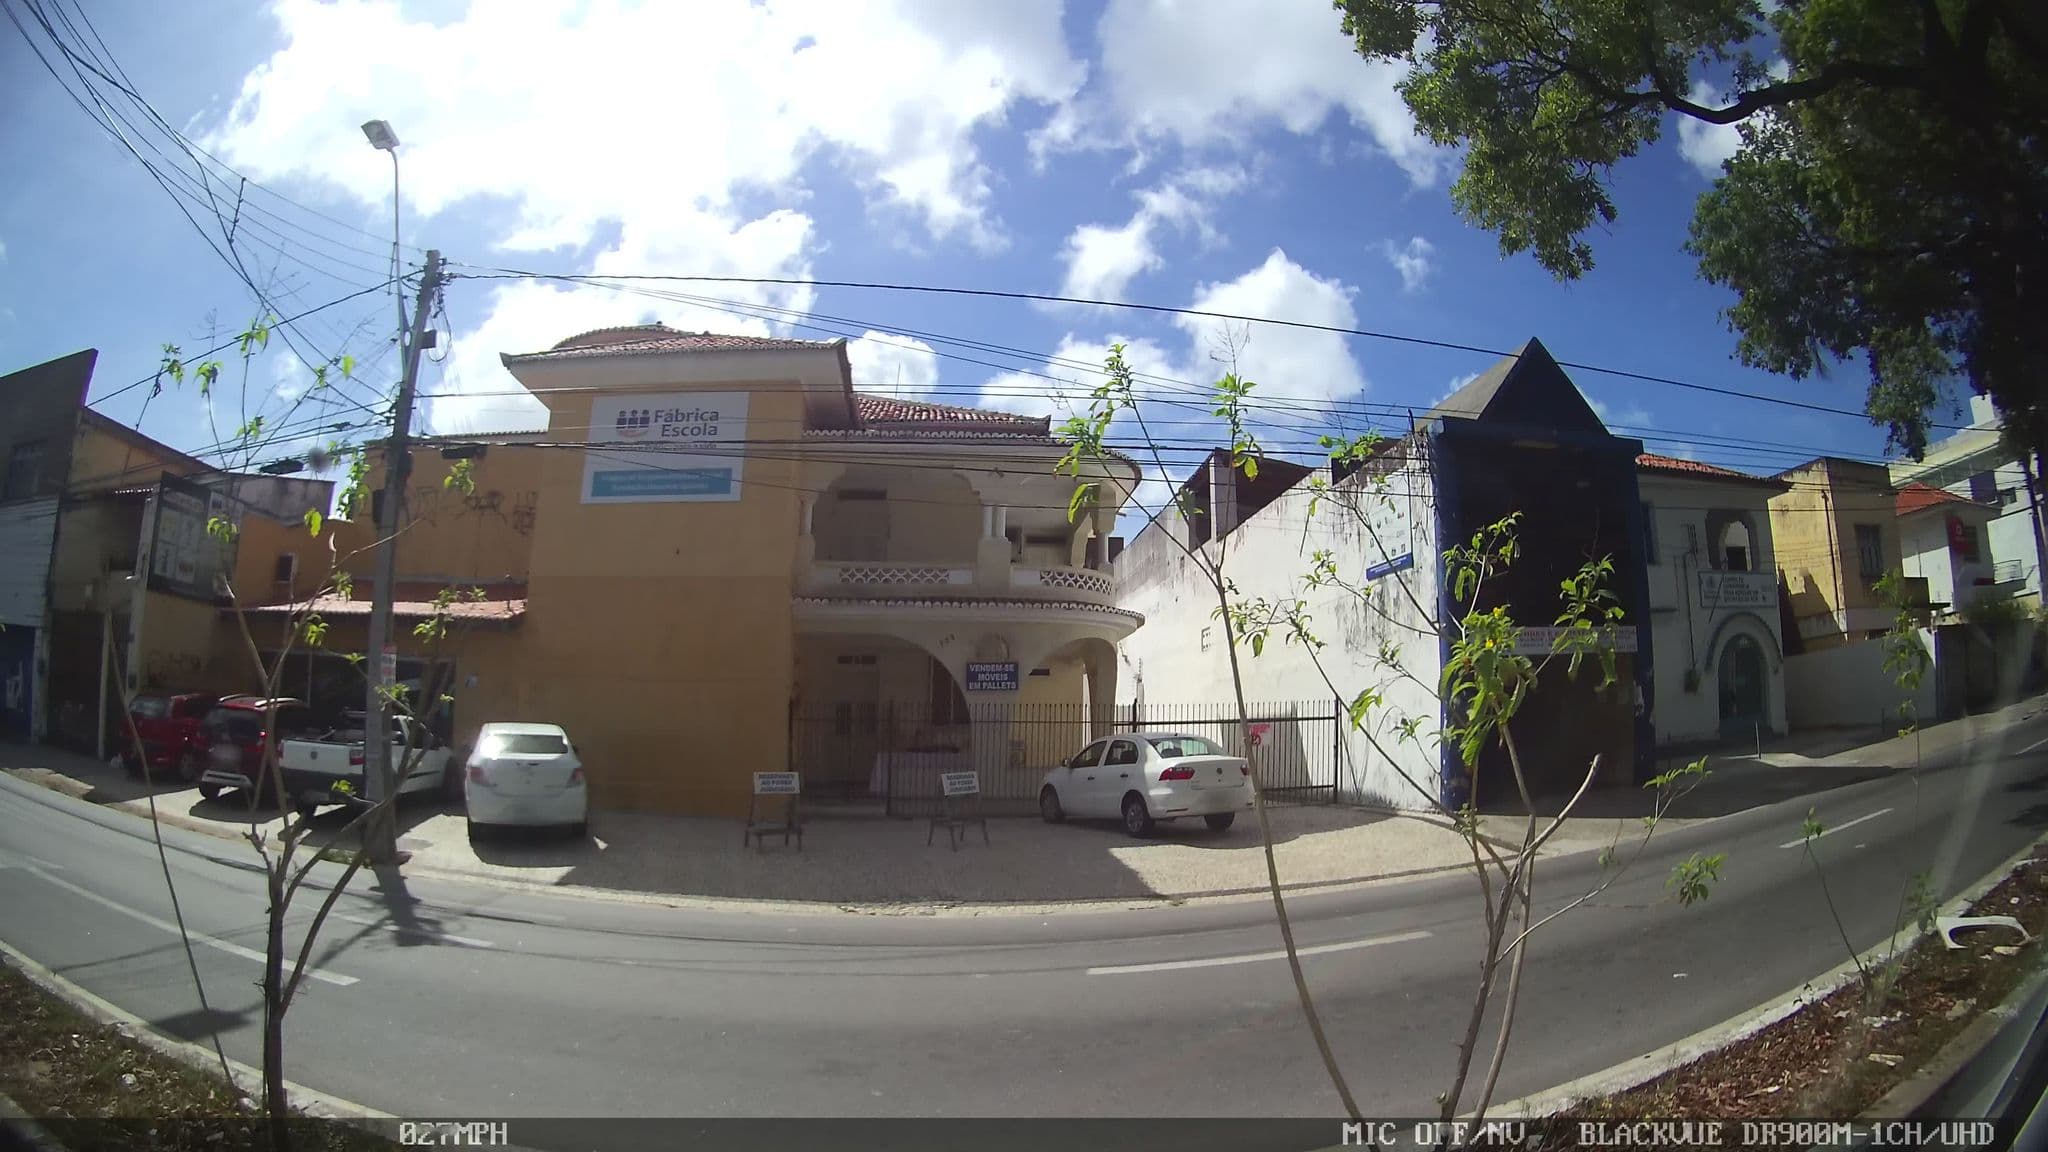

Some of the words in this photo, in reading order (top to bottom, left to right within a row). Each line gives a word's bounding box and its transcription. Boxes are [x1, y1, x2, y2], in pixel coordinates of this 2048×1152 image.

[654, 408, 720, 423] Fábrica
[661, 423, 718, 437] Escola
[969, 664, 1015, 672] VENDEM-SE
[977, 672, 1008, 681] MÓVEIS
[982, 681, 1016, 690] PALLETS
